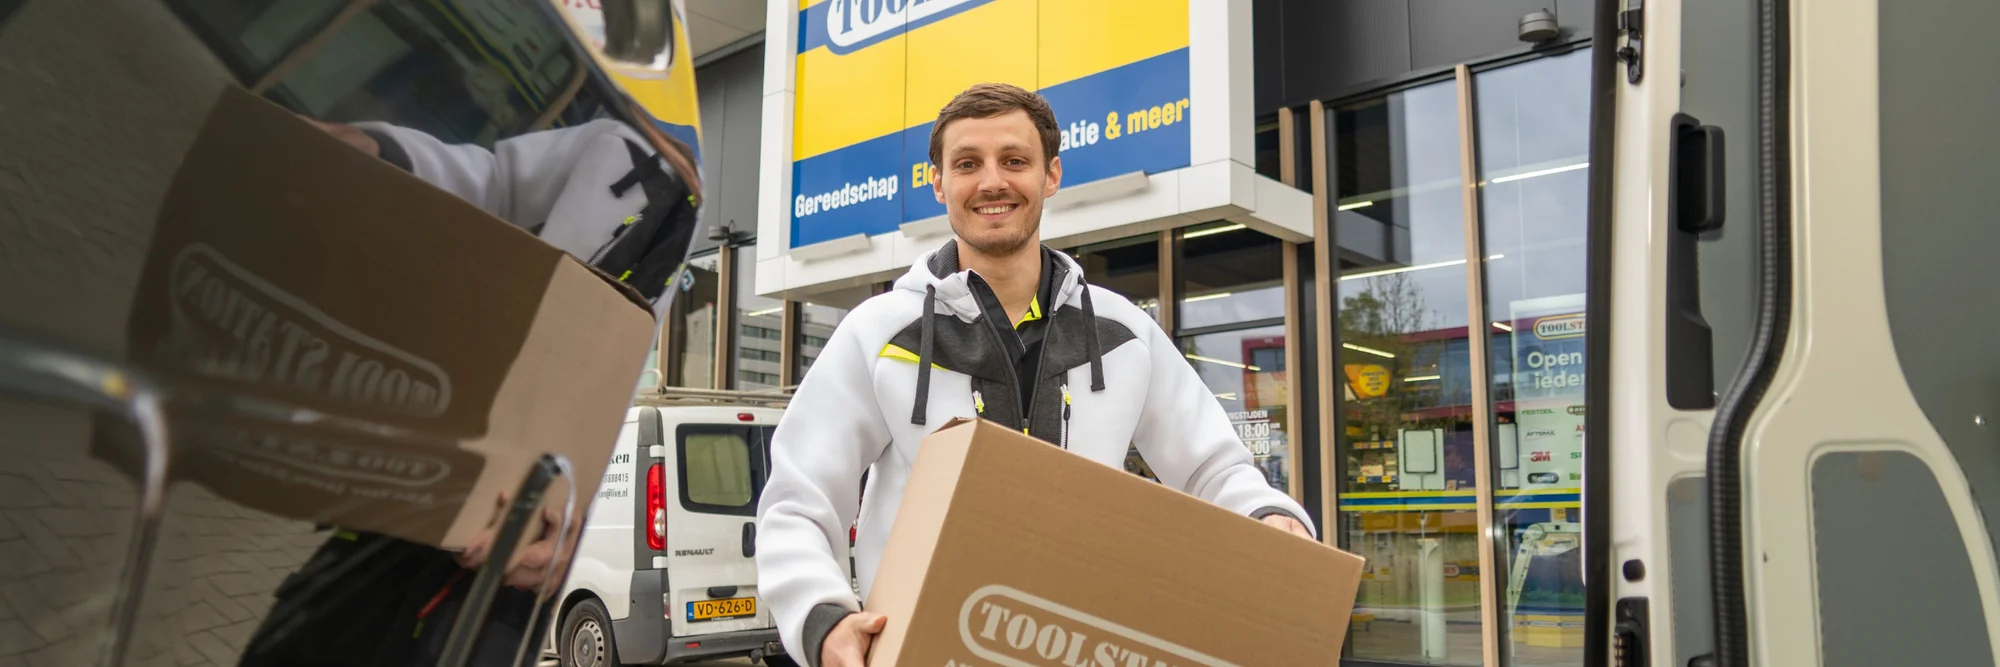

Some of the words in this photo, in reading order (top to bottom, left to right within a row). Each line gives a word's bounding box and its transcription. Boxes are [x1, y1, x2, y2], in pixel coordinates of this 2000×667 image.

[795, 175, 898, 218] Gereedschap
[1060, 120, 1100, 152] atie
[1105, 111, 1122, 140] &
[1127, 98, 1190, 135] meer
[1527, 351, 1583, 371] Open
[1238, 423, 1270, 438] 18:00
[1244, 440, 1270, 455] 7:00
[1530, 451, 1551, 462] 3M
[675, 548, 714, 557] RENAULT
[697, 599, 752, 616] VD-626-D
